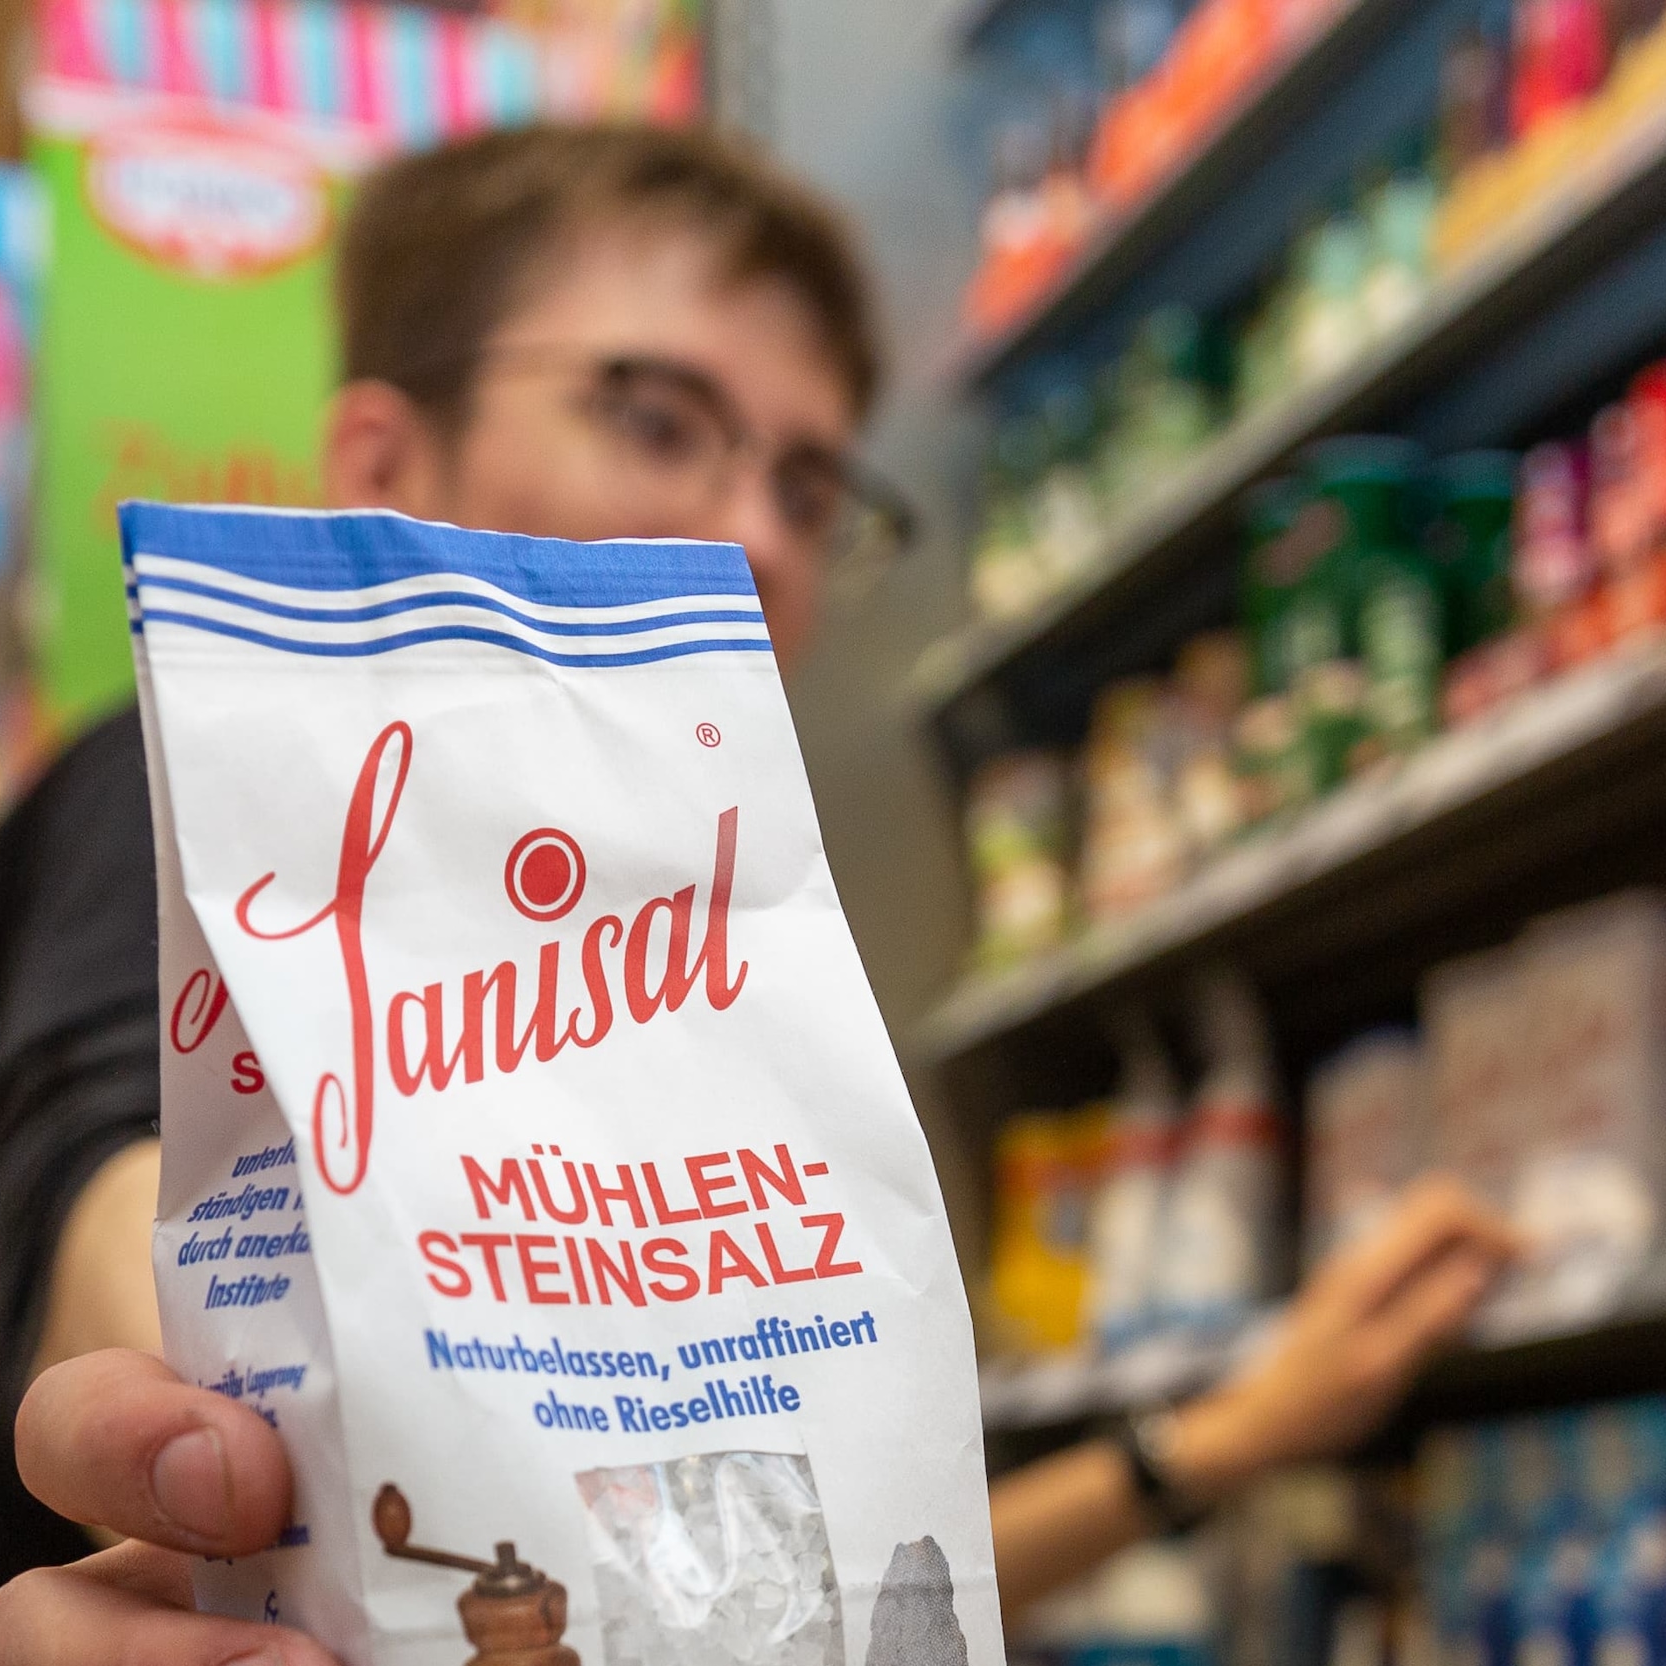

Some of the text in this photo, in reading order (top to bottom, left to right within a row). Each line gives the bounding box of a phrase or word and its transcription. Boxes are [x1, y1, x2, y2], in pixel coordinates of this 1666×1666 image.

[234, 720, 749, 1196] Sanisal
[187, 1182, 290, 1222] ständigen
[459, 1143, 830, 1228] MÜHLEN-
[177, 1220, 312, 1267] durch anerka
[416, 1212, 864, 1308] STEINSALZ
[204, 1272, 291, 1310] Institute
[423, 1310, 879, 1382] Naturbelassen, unraffiniert
[533, 1373, 801, 1434] ohne Rieselhilfe
